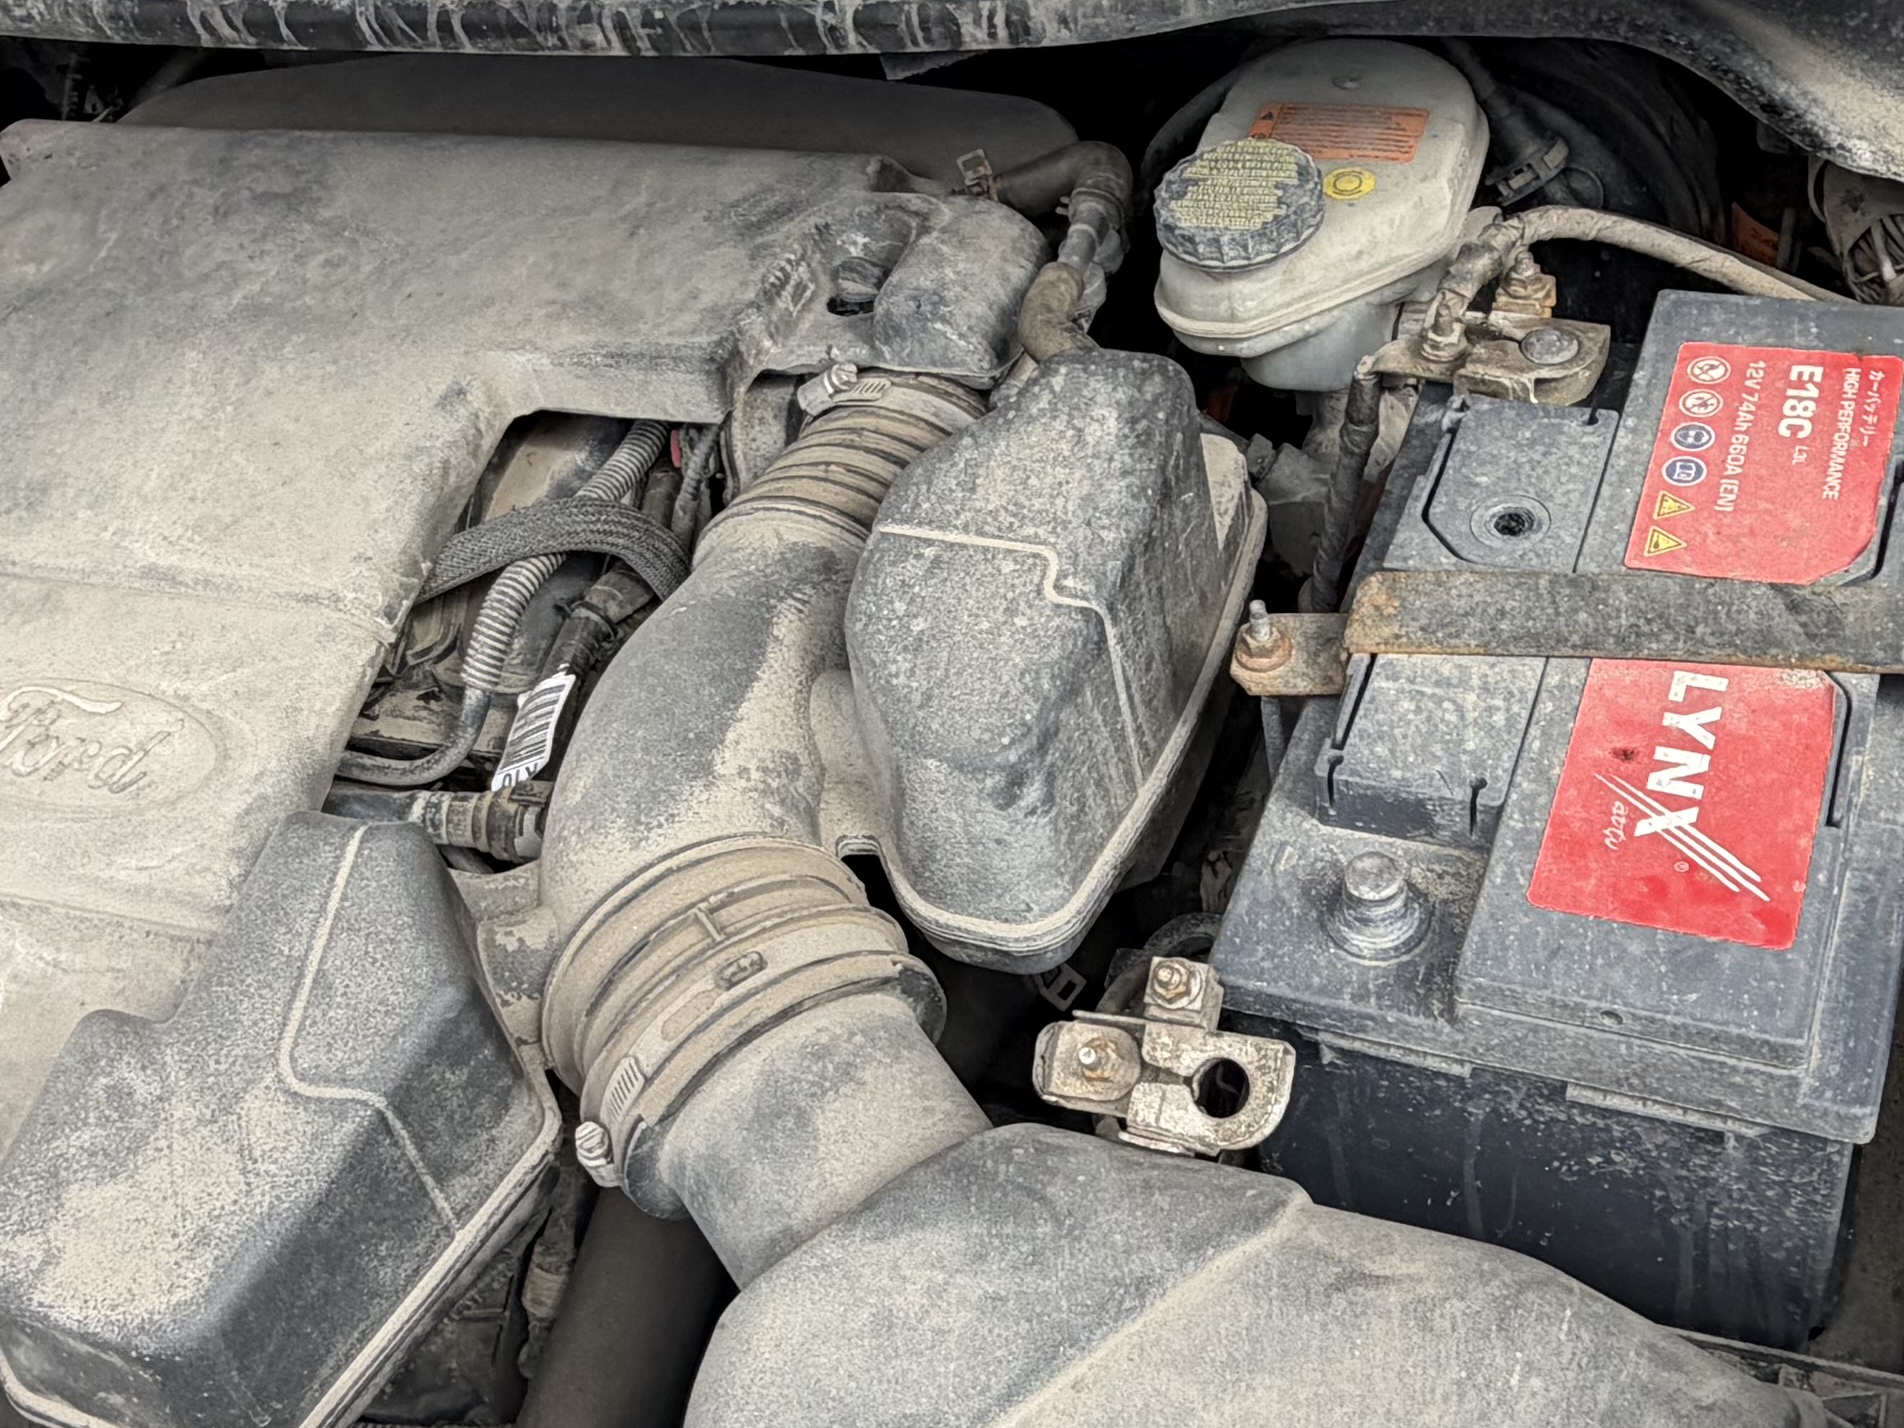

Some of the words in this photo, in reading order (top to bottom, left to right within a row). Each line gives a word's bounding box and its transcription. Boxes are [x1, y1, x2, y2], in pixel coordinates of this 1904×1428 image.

[1744, 360, 1767, 390] 12V
[1842, 367, 1862, 399] HIGH
[1733, 392, 1759, 431] 74Ah
[1777, 364, 1824, 439] E18C
[1723, 433, 1750, 476] 660A
[1822, 400, 1856, 501] PERFORMANCE
